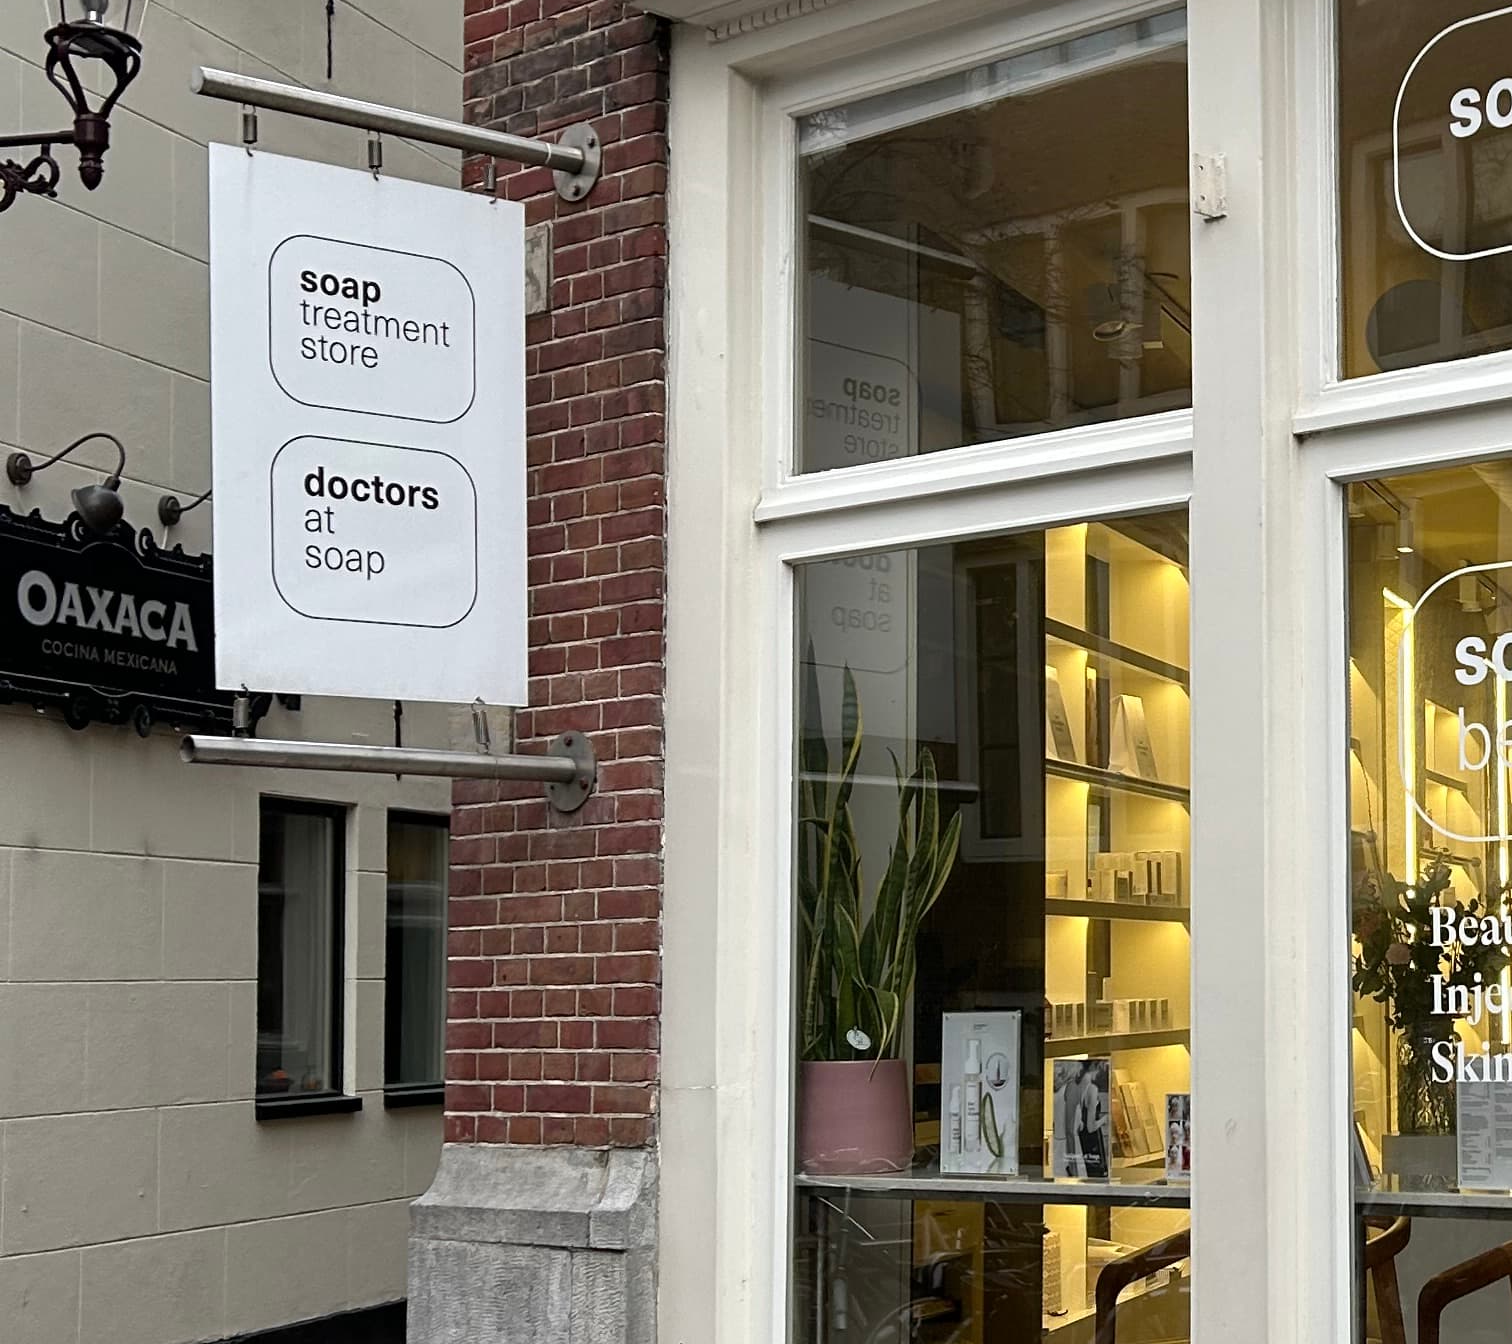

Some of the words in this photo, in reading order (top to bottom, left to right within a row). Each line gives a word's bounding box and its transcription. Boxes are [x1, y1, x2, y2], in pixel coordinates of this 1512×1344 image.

[300, 269, 381, 307] soap
[299, 299, 450, 347] treatment
[301, 335, 378, 368] store
[304, 465, 439, 510] doctors
[304, 506, 335, 534] at
[305, 544, 385, 581] soap
[17, 569, 199, 652] OAXACA
[41, 639, 100, 662] COCINA
[103, 647, 178, 675] MEXICANA
